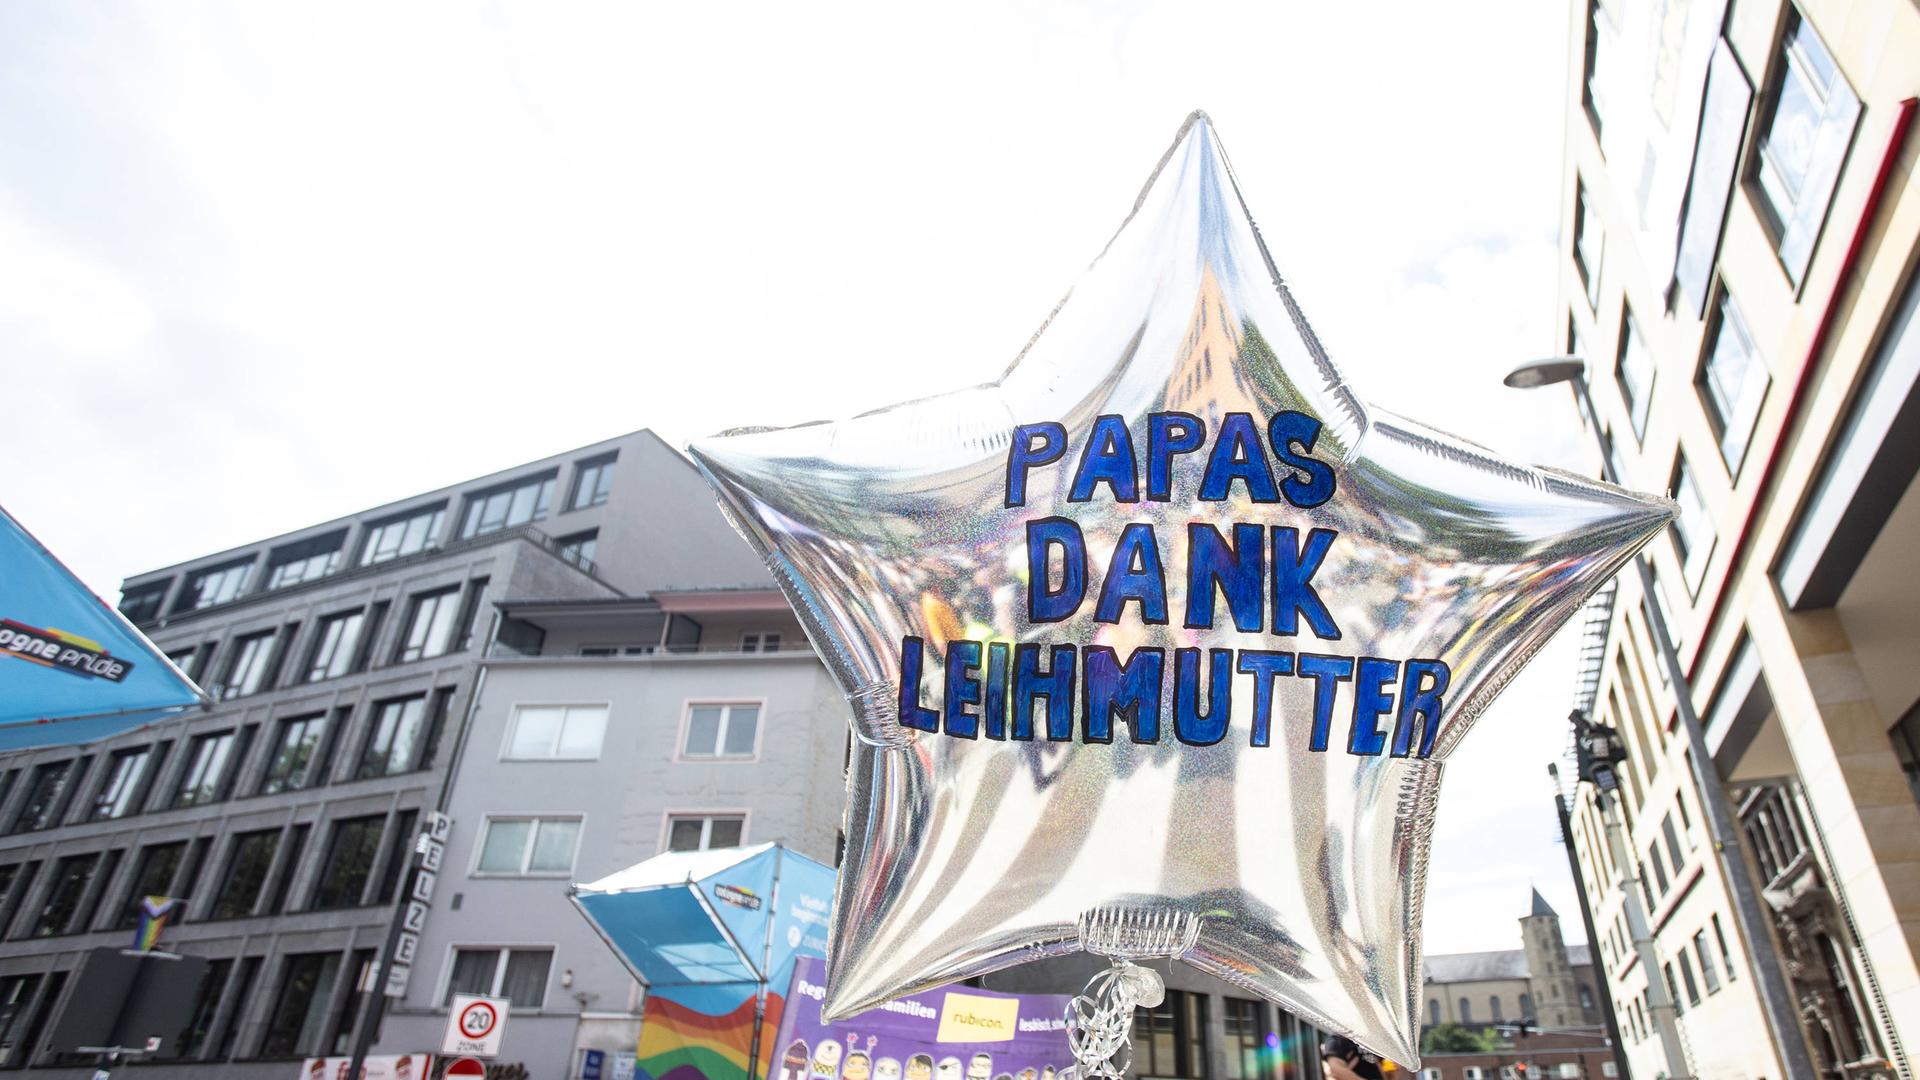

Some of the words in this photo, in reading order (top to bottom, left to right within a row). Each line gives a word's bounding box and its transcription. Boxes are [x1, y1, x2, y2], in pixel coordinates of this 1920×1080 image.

[1004, 410, 1336, 509] PAPAS
[1026, 515, 1342, 640] DANK
[0, 627, 61, 659] ogne
[58, 647, 124, 679] pride
[898, 636, 1451, 759] LEIHMUTTER
[399, 818, 448, 960] PELZE
[457, 1041, 486, 1052] ZONE
[467, 1011, 490, 1029] 20
